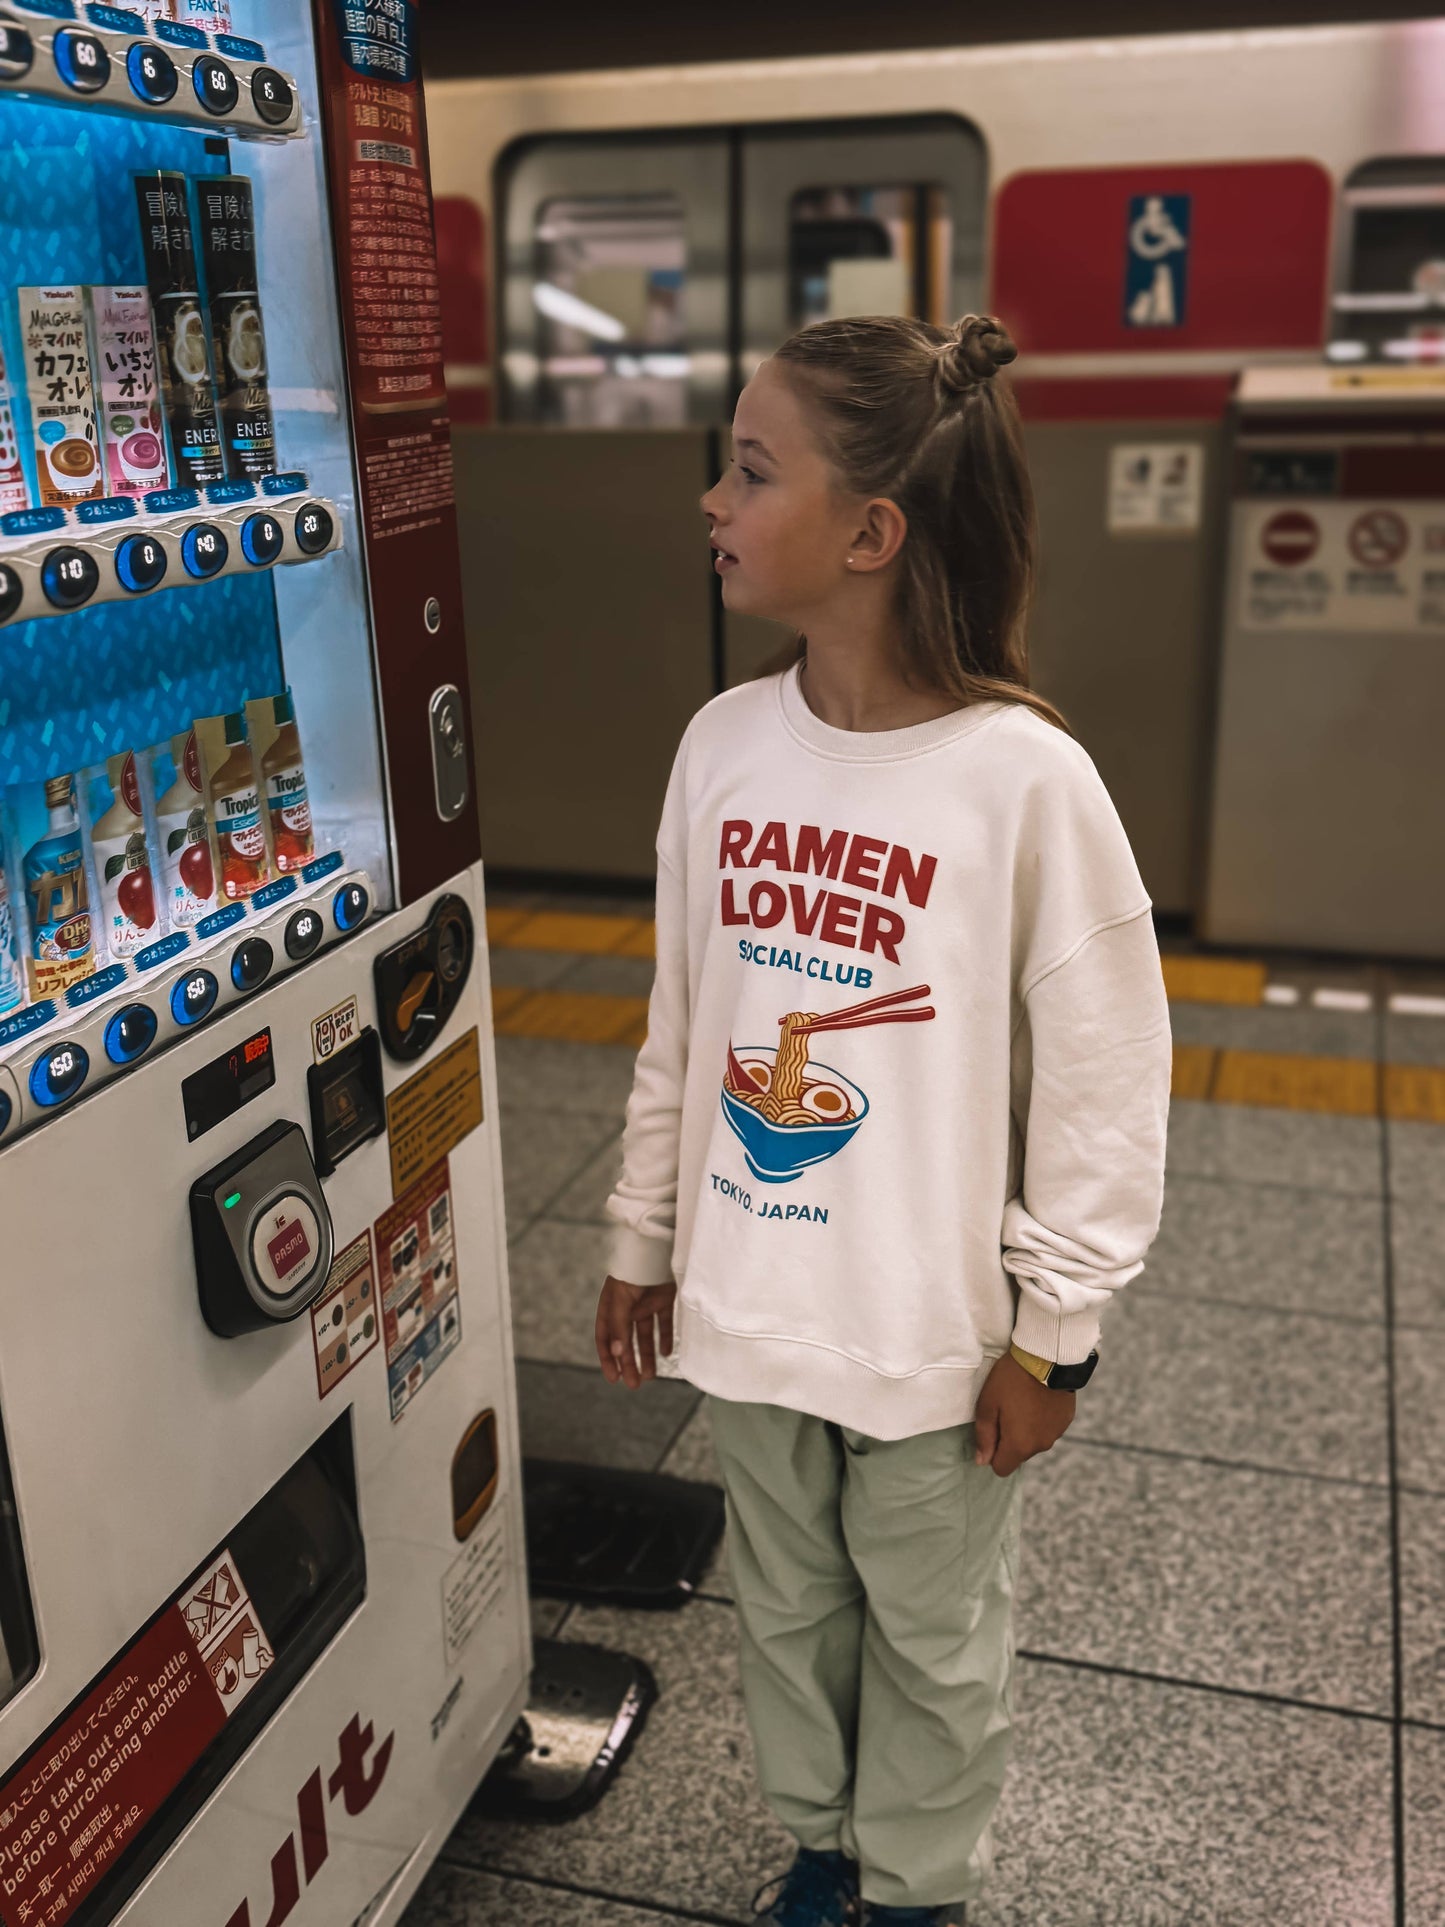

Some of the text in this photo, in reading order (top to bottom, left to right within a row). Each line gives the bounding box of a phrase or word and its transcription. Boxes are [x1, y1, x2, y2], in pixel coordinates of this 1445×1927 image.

[34, 350, 88, 377] カフェ
[719, 819, 938, 909] RAMEN
[721, 878, 906, 966] LOVER
[738, 939, 873, 989] SOCIAL CLUB
[339, 1022, 353, 1042] OK
[757, 1201, 828, 1225] JAPAN
[274, 1232, 304, 1265] PASMO
[210, 1648, 228, 1677] Good
[0, 1650, 188, 1875] Please take out each bottle
[3, 1670, 197, 1897] before purchasing another.
[46, 1804, 144, 1922] 구매 시마다 꺼내 주세요
